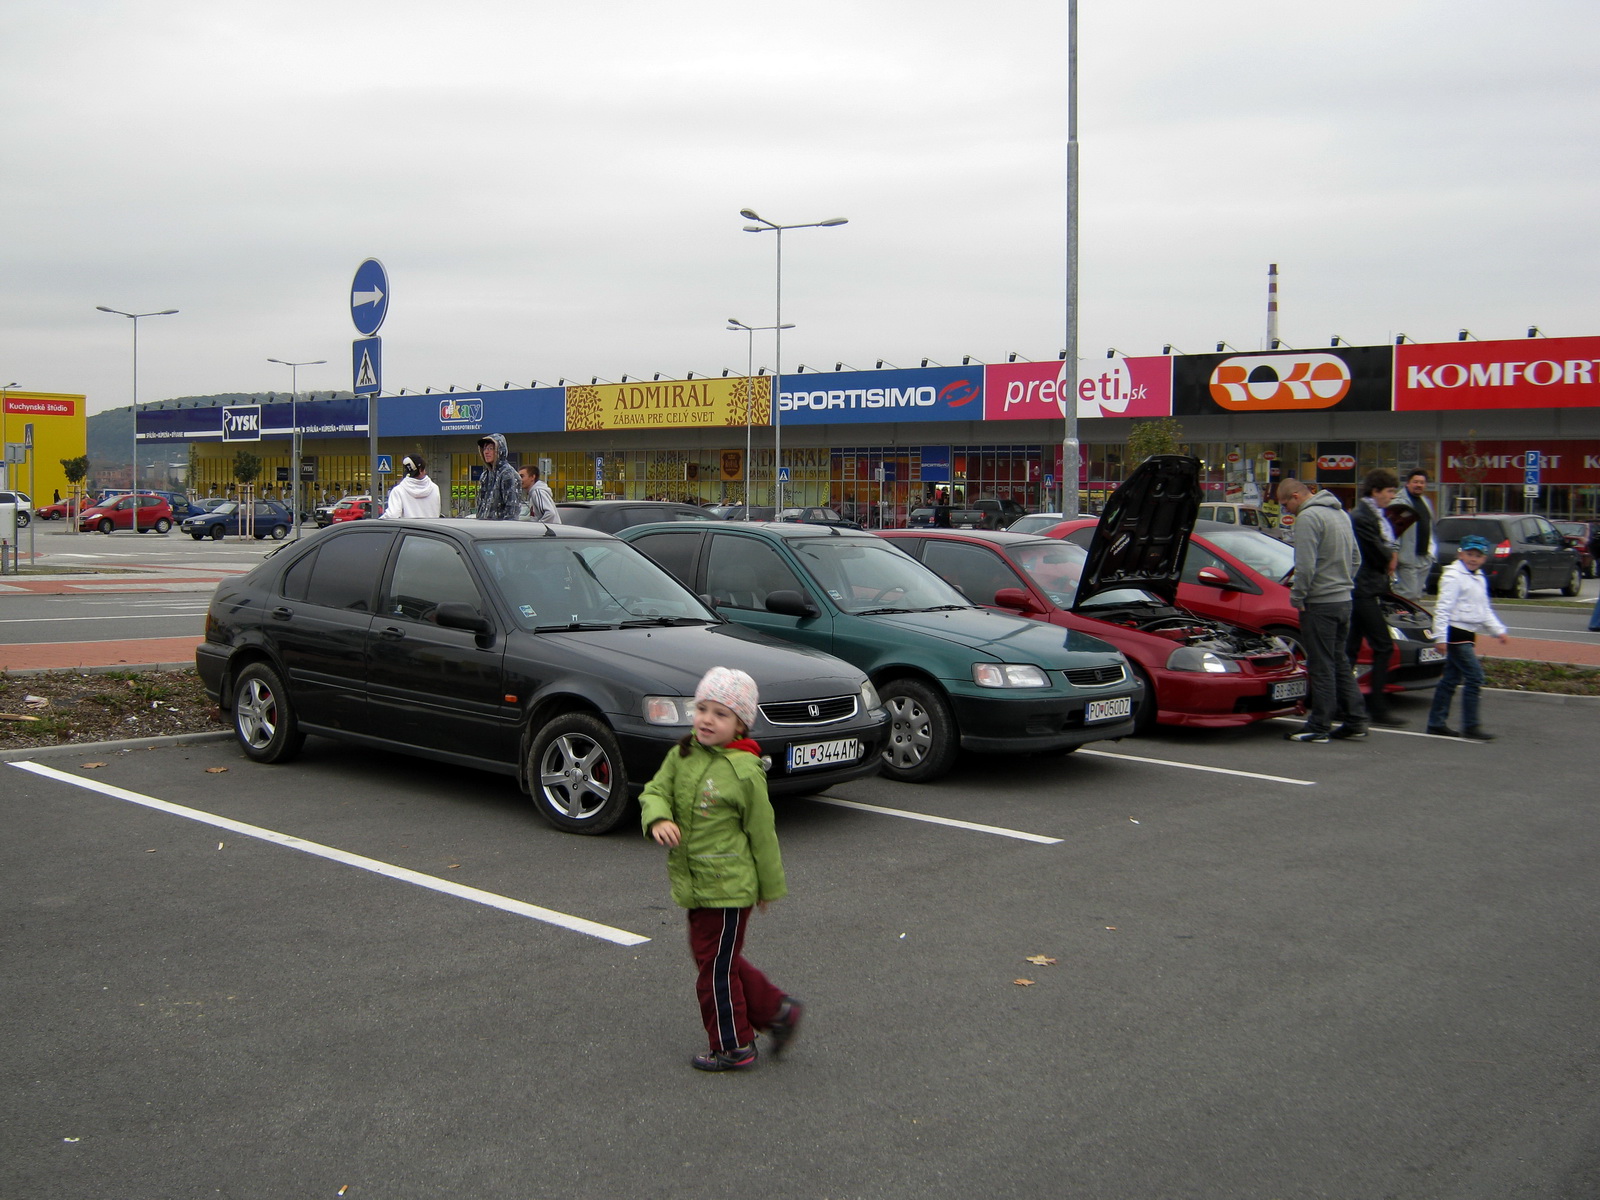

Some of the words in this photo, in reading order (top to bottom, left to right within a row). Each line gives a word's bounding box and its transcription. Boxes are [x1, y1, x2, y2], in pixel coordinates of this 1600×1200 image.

[1217, 362, 1344, 401] ROKO
[9, 402, 46, 411] Kuchynské
[614, 383, 715, 410] ADMIRAL
[779, 386, 936, 411] SPORTISIMO
[230, 414, 258, 432] JYSK
[613, 412, 645, 425] ZÁBAVA
[647, 413, 664, 424] PRE
[666, 409, 691, 423] CELÝ
[691, 411, 715, 422] SVET
